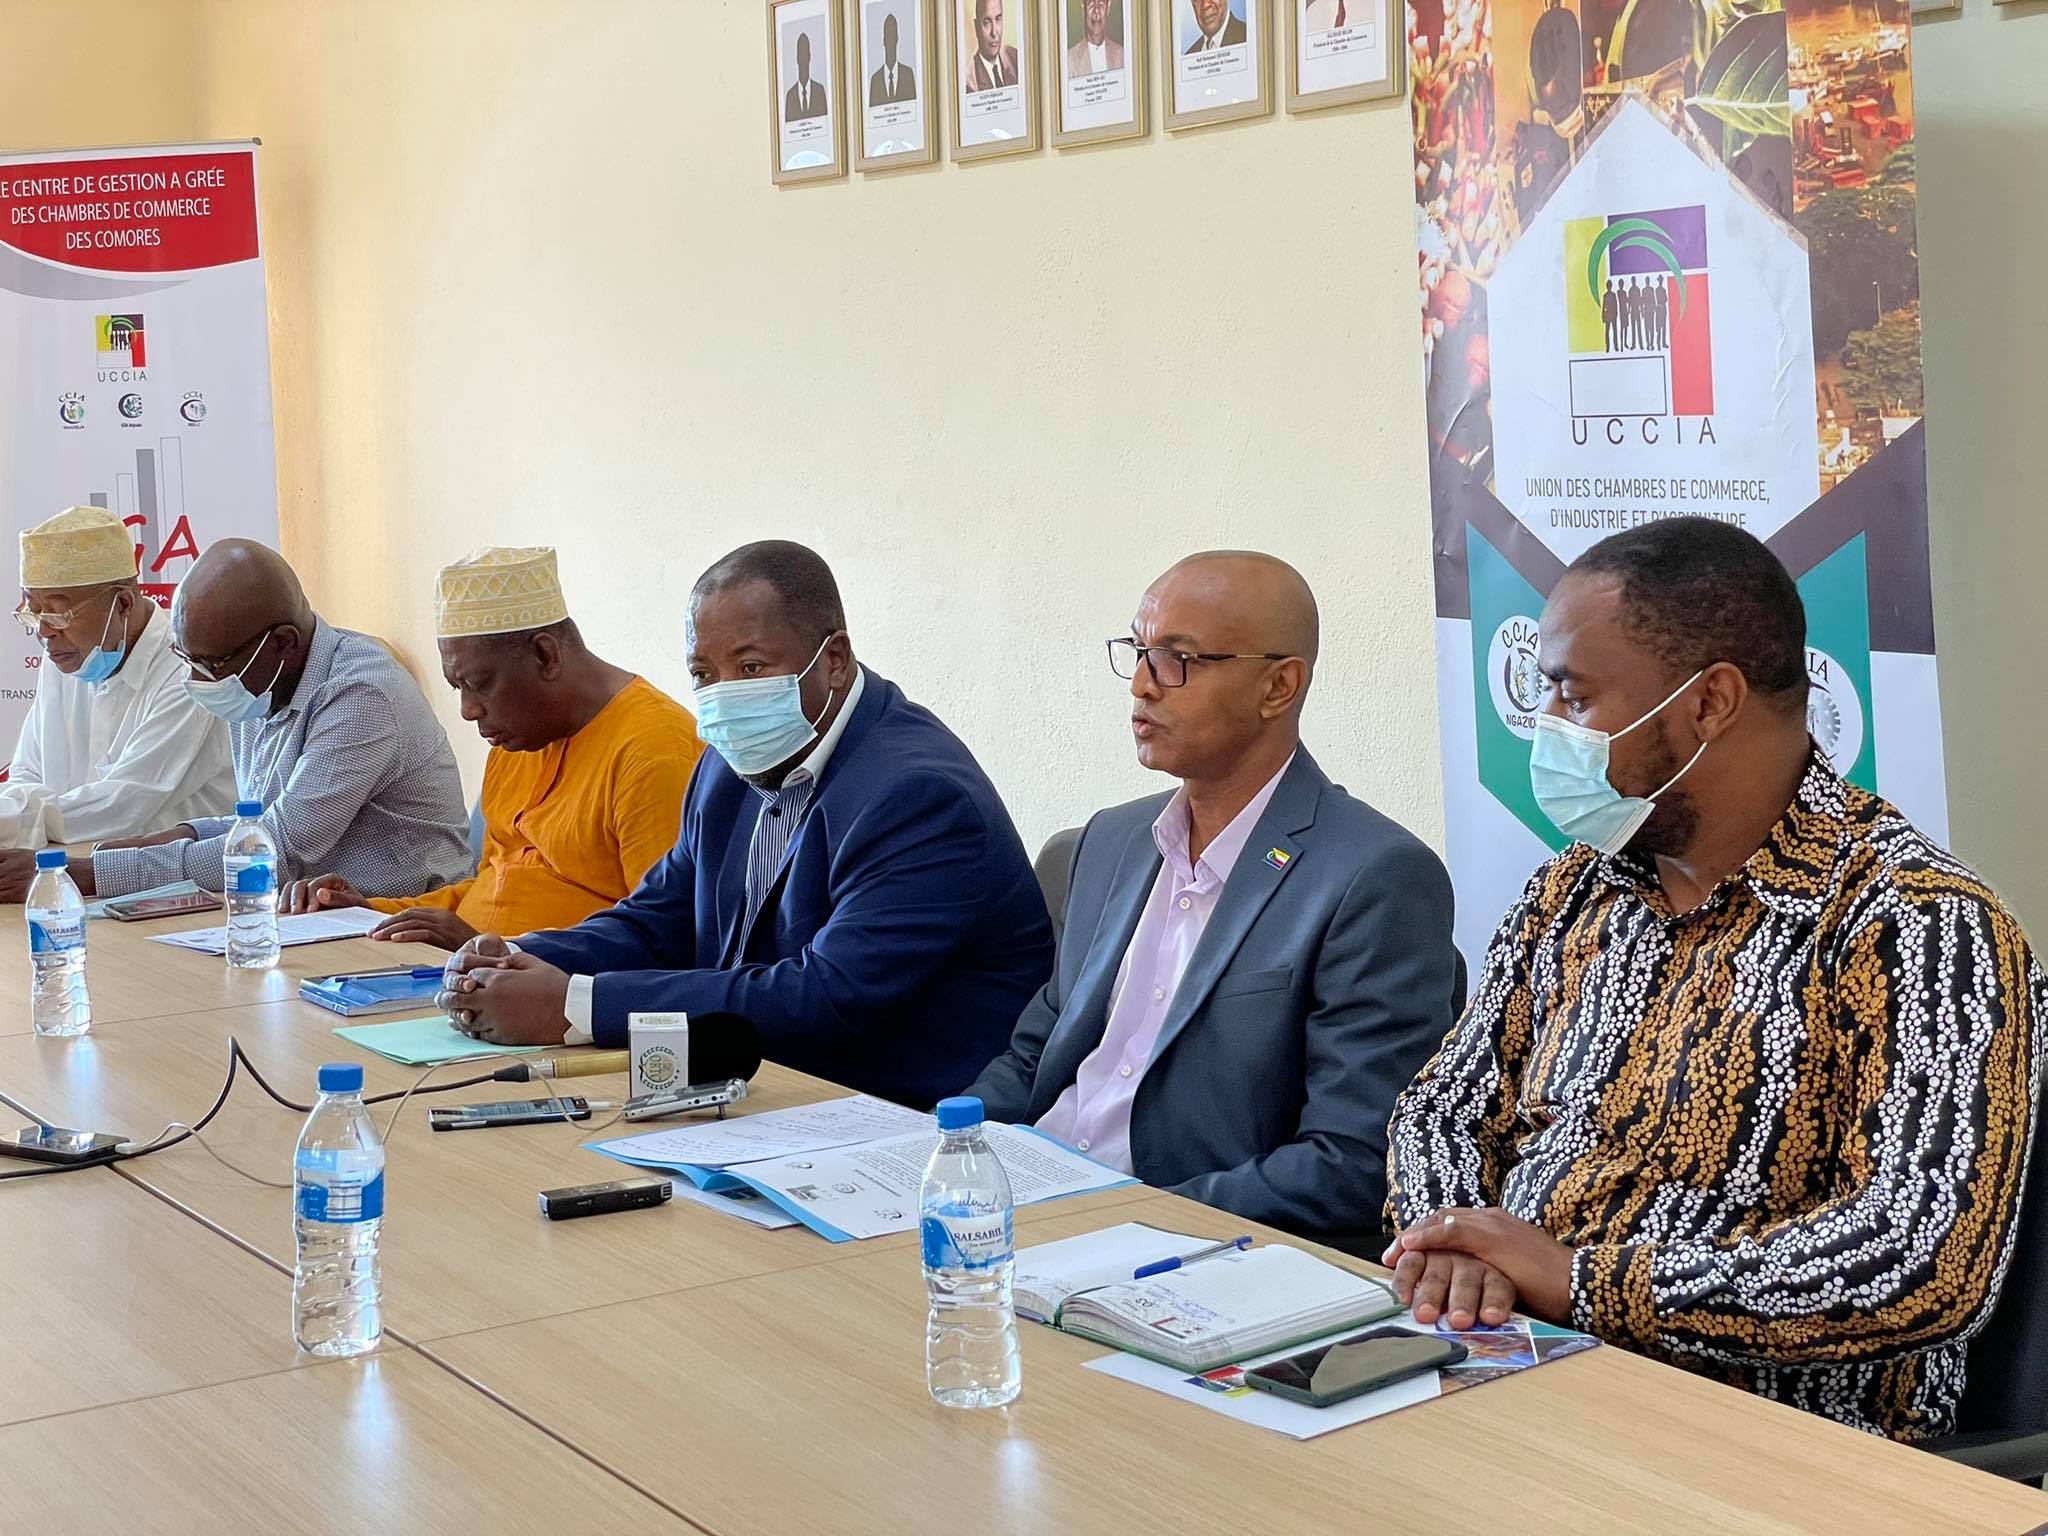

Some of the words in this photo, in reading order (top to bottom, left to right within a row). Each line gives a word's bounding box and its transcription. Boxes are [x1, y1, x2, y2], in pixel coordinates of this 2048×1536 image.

[0, 181, 10, 199] E
[12, 177, 71, 197] CENTRE
[73, 176, 95, 195] DE
[98, 172, 166, 192] GESTION
[170, 171, 182, 189] A
[185, 165, 225, 188] GRÉE
[11, 206, 36, 225] DES
[38, 203, 111, 223] CHAMBRES
[113, 201, 131, 220] DE
[133, 197, 211, 218] COMMERCE
[66, 231, 92, 249] DES
[94, 228, 161, 248] COMORES
[97, 370, 148, 383] UCCIA
[1572, 417, 1716, 445] UCCIA
[1526, 478, 1562, 498] UNION
[1566, 478, 1591, 498] DES
[1594, 478, 1667, 499] CHAMBRES
[1670, 479, 1688, 499] DE
[1690, 479, 1770, 505] COMMERCE,
[1551, 509, 1628, 529] D'INDUSTRIE
[1632, 510, 1647, 527] ET
[1502, 621, 1539, 650] CCIA
[1808, 651, 1829, 684] IA
[1506, 714, 1537, 729] NGAZID
[953, 1227, 1004, 1241] SALSABIL
